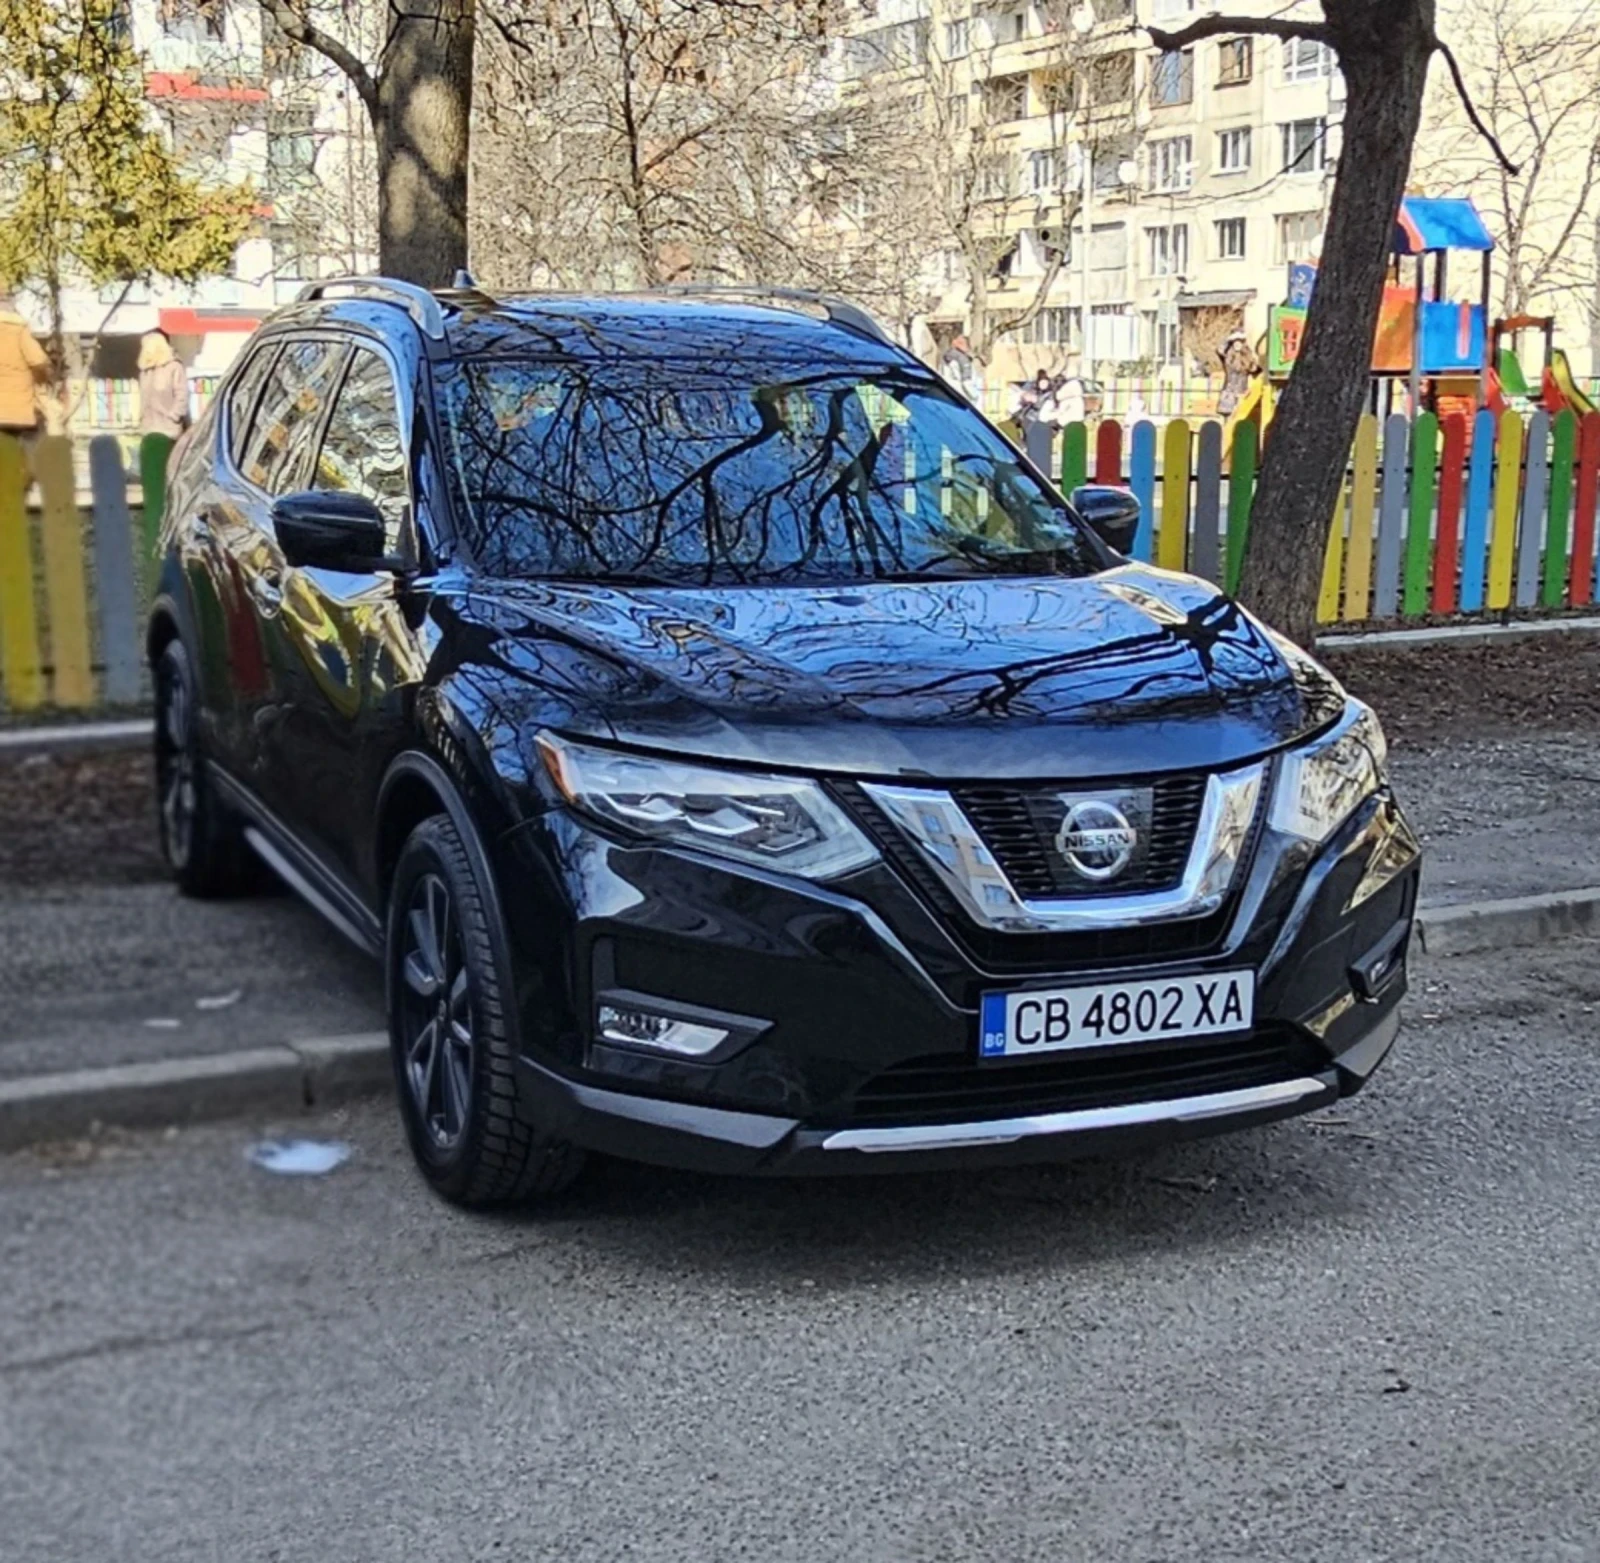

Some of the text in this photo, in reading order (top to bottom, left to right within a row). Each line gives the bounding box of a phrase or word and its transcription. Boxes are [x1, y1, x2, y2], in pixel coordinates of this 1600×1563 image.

[1065, 832, 1130, 849] NISSAN
[1015, 980, 1243, 1045] CB 4802 XA
[984, 1032, 1005, 1049] BG
